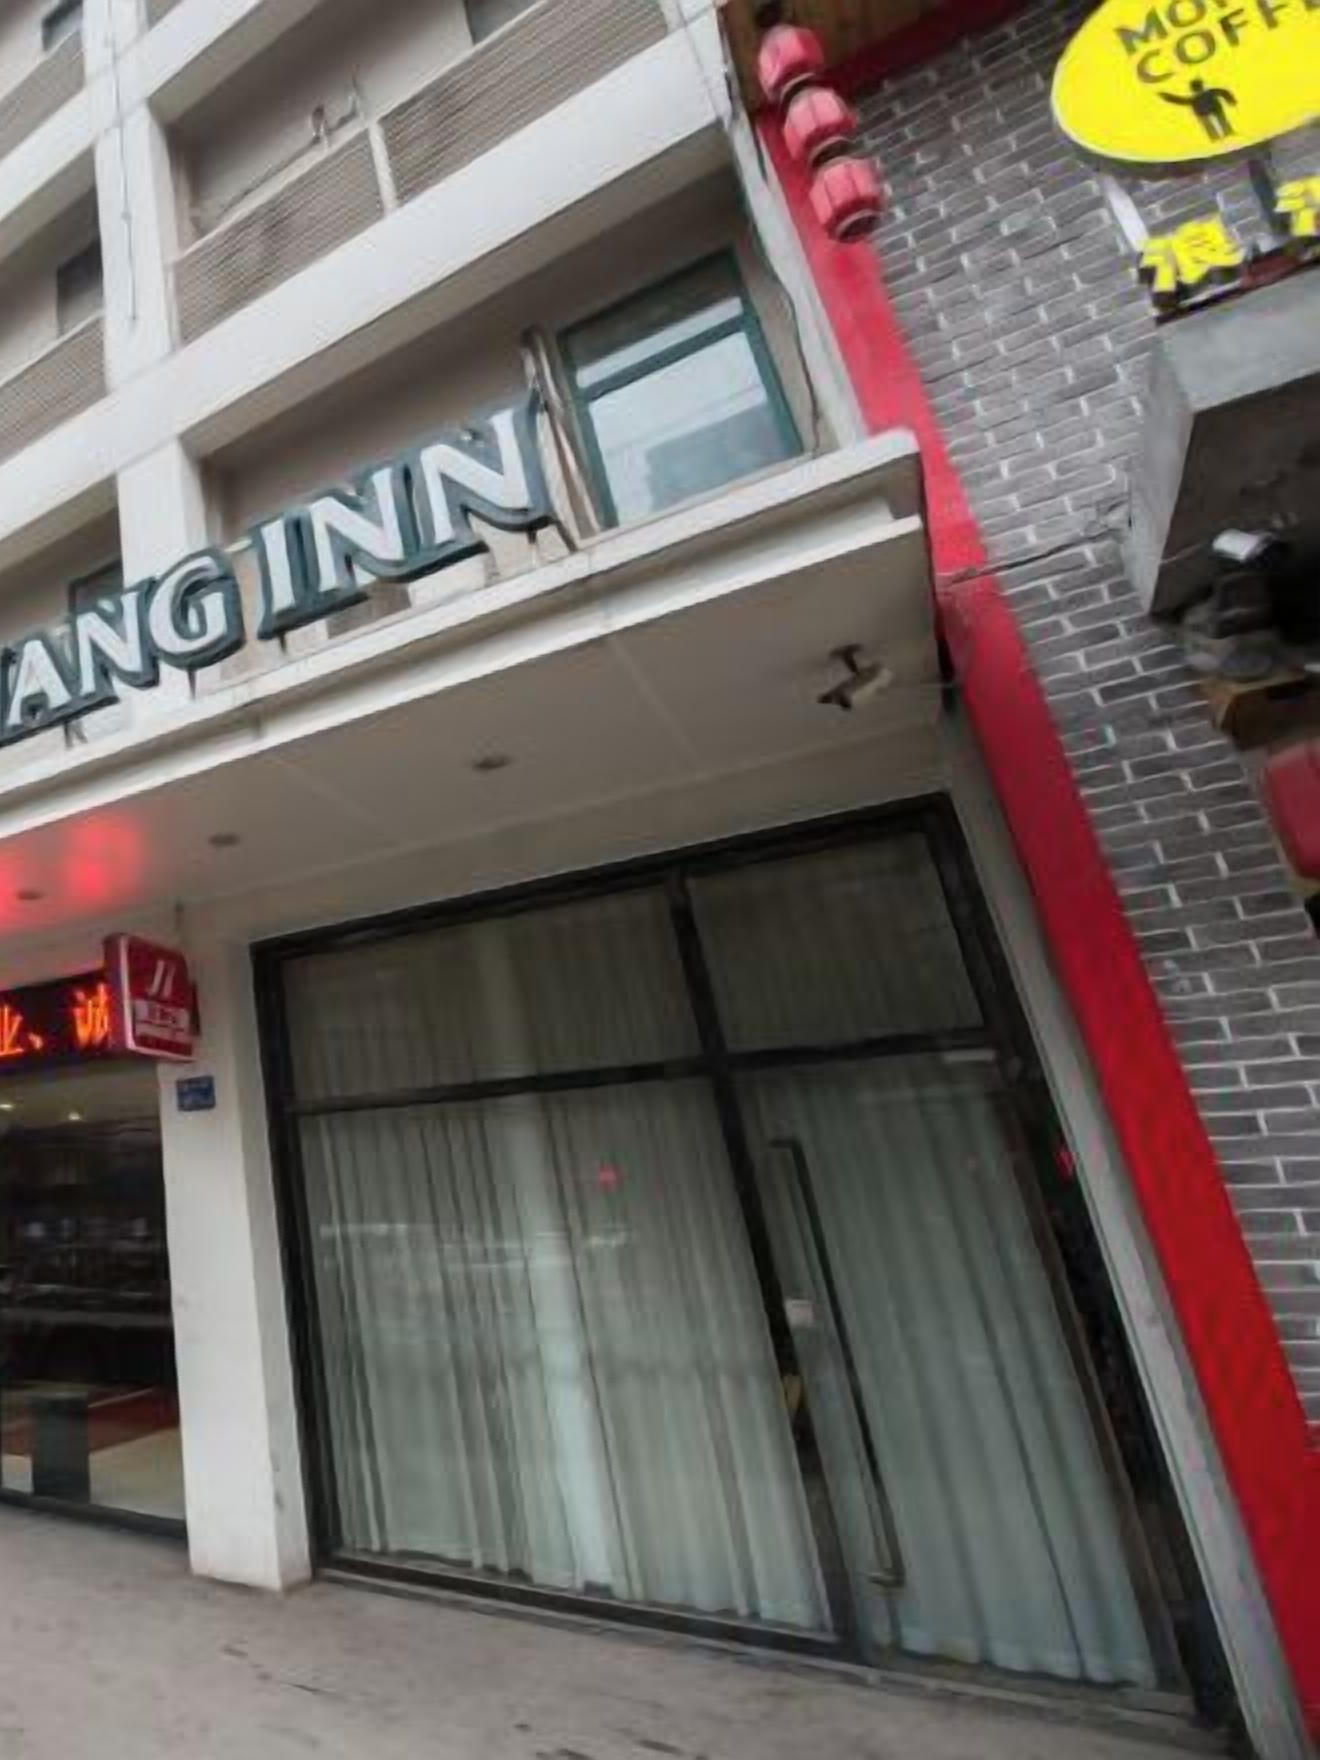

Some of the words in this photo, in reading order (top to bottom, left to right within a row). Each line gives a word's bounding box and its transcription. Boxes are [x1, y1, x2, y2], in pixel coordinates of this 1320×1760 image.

[1114, 0, 1228, 54] MO
[1136, 0, 1320, 84] COFF
[257, 402, 542, 632] INN
